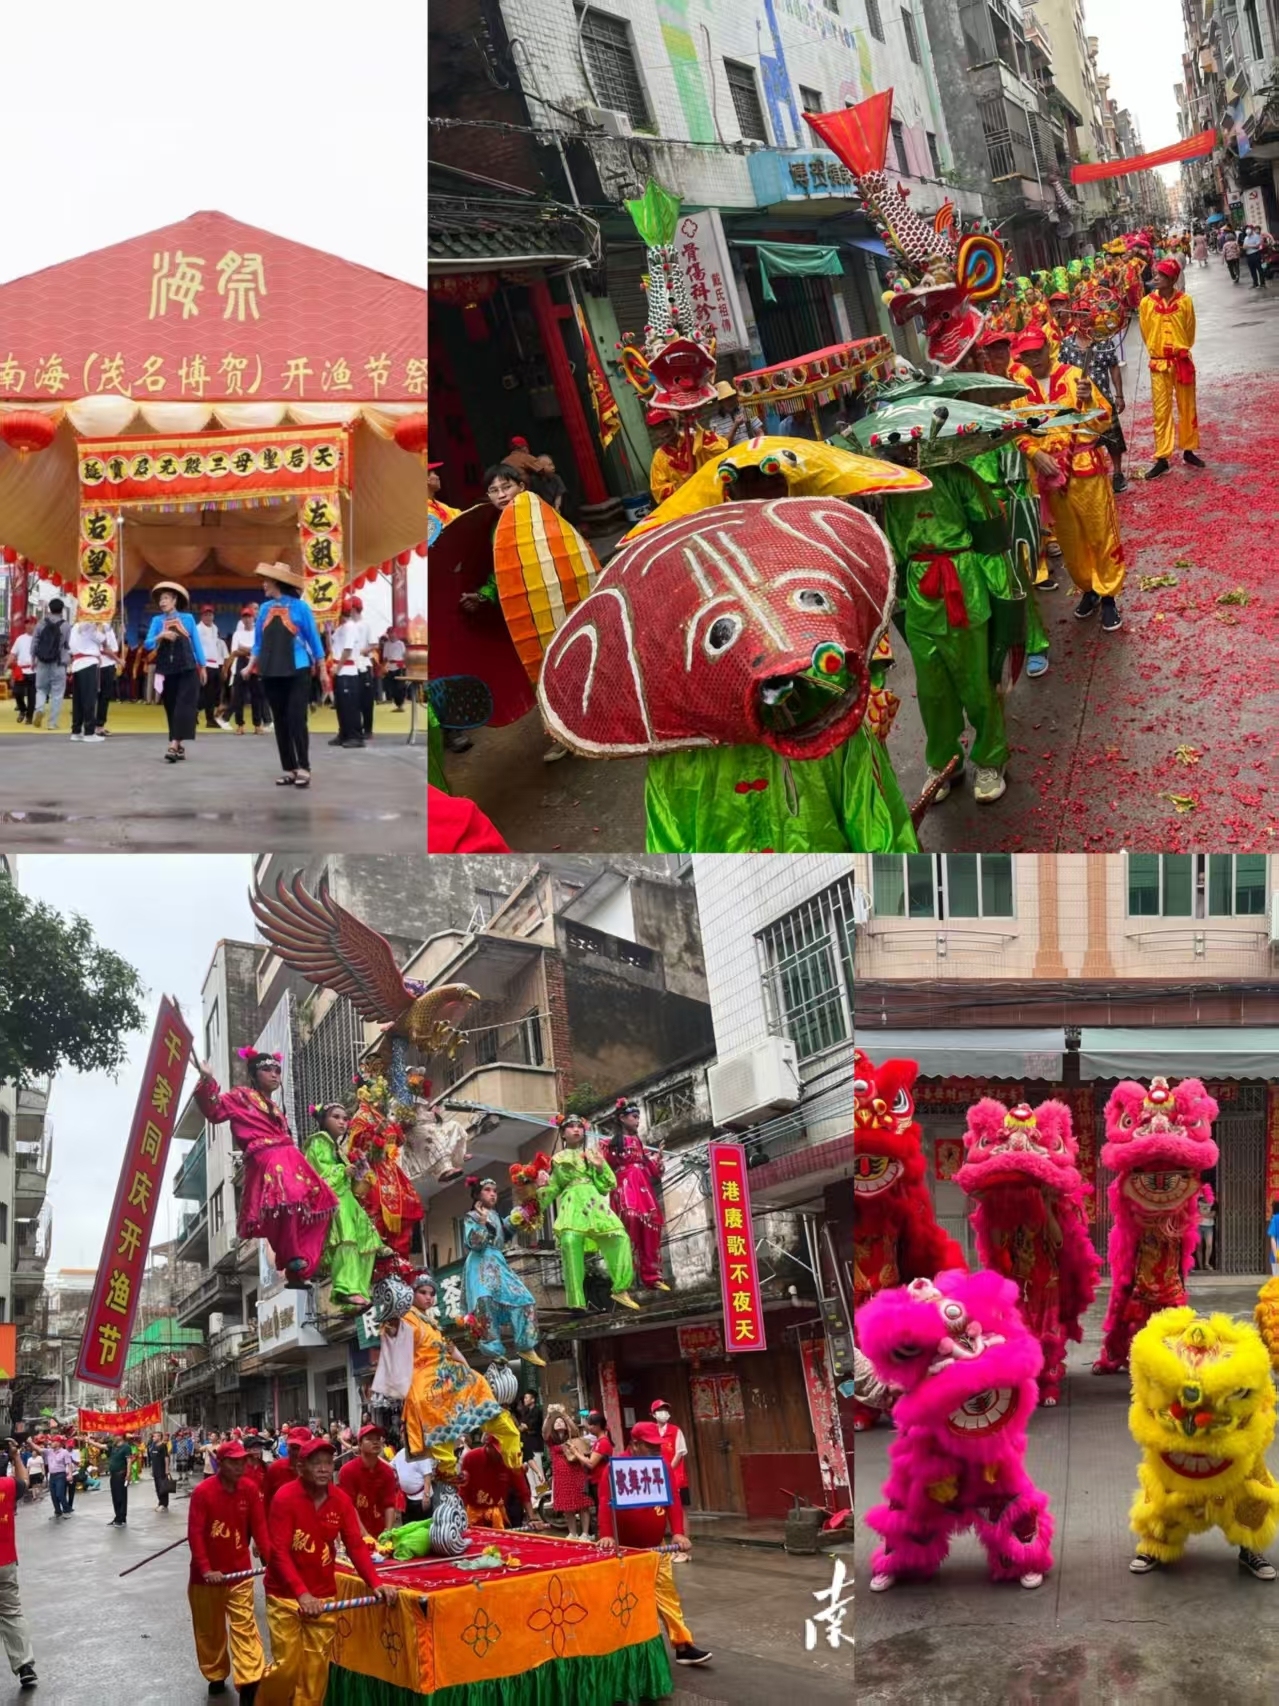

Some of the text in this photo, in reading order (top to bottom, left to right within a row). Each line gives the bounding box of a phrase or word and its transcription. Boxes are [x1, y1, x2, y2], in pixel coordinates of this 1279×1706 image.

[98, 1028, 183, 1366] 千家同庆开渔节
[718, 1159, 756, 1341] 一港赓歌不夜天
